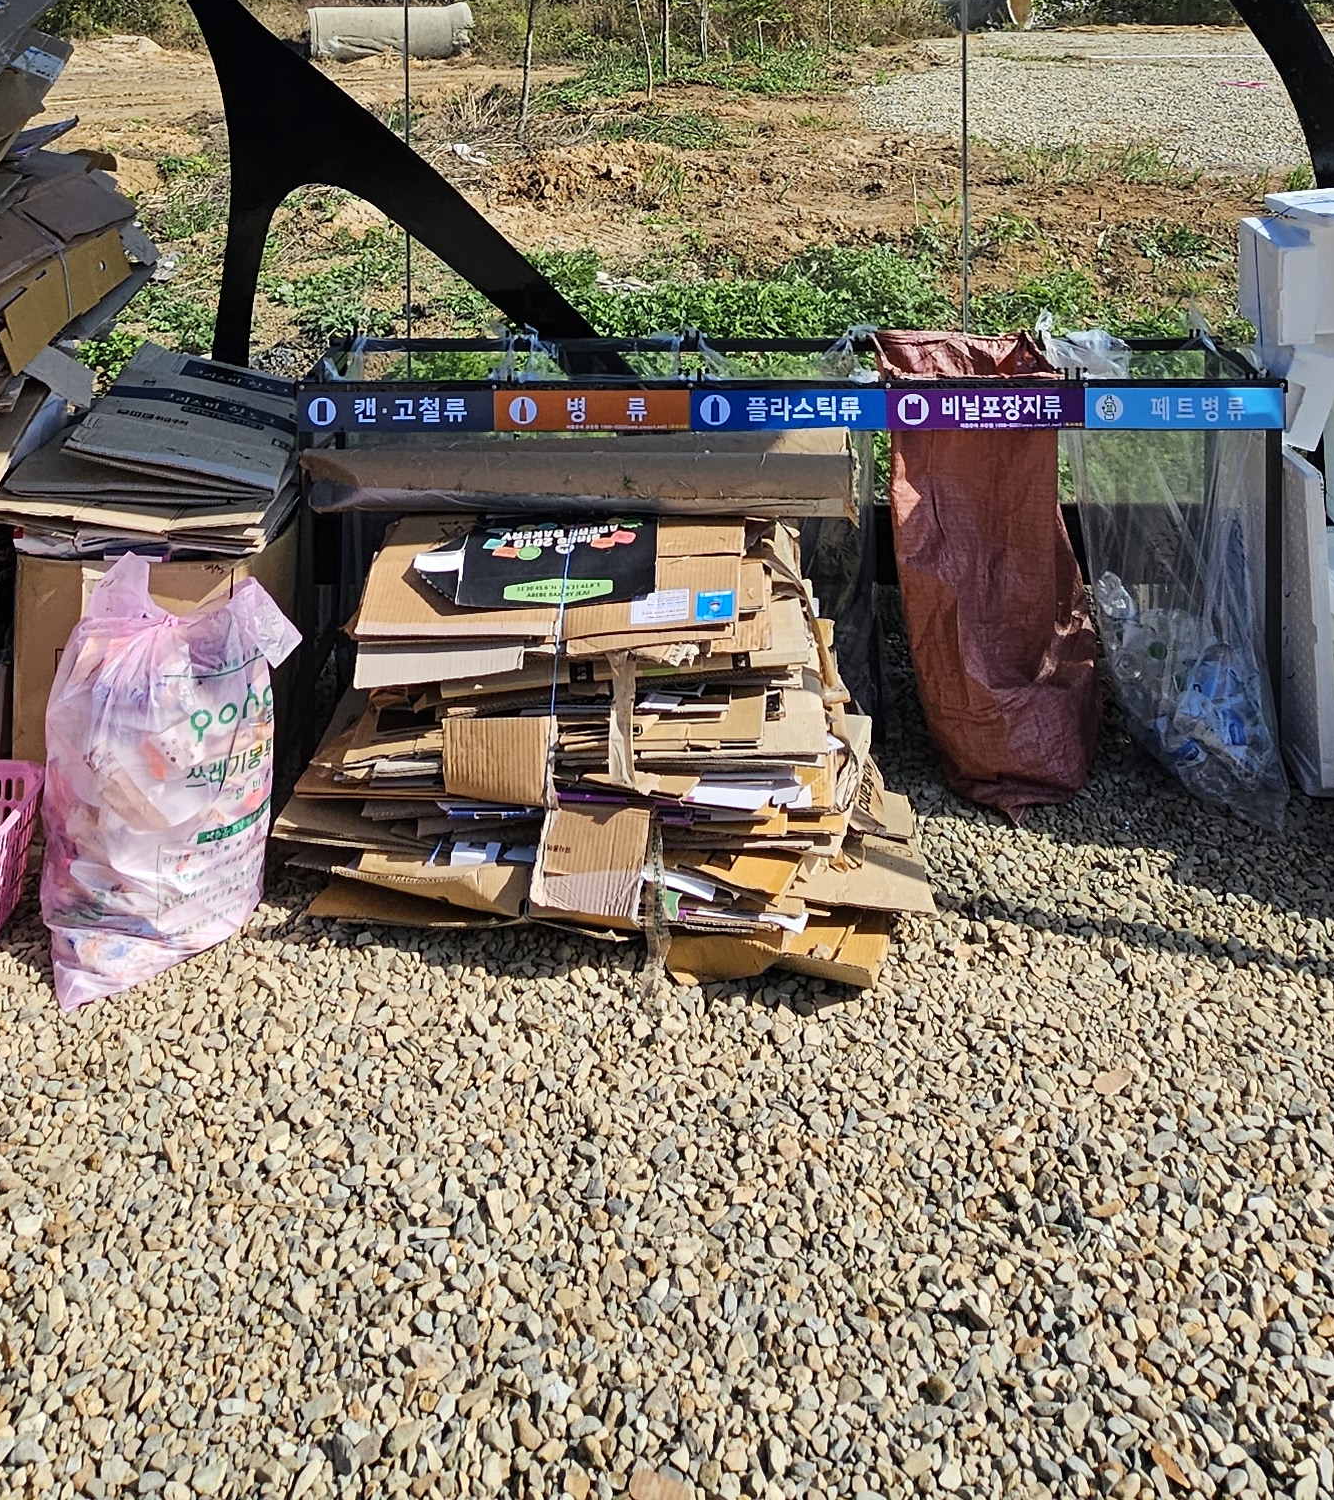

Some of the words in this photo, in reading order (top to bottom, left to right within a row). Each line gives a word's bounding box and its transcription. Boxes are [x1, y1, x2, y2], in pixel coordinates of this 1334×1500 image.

[354, 397, 468, 423] 캔·고철류
[746, 396, 862, 423] 플라스틱류
[941, 395, 1063, 421] 비닐포장지류
[1150, 396, 1247, 422] 페트병류
[549, 590, 573, 598] BAKRY
